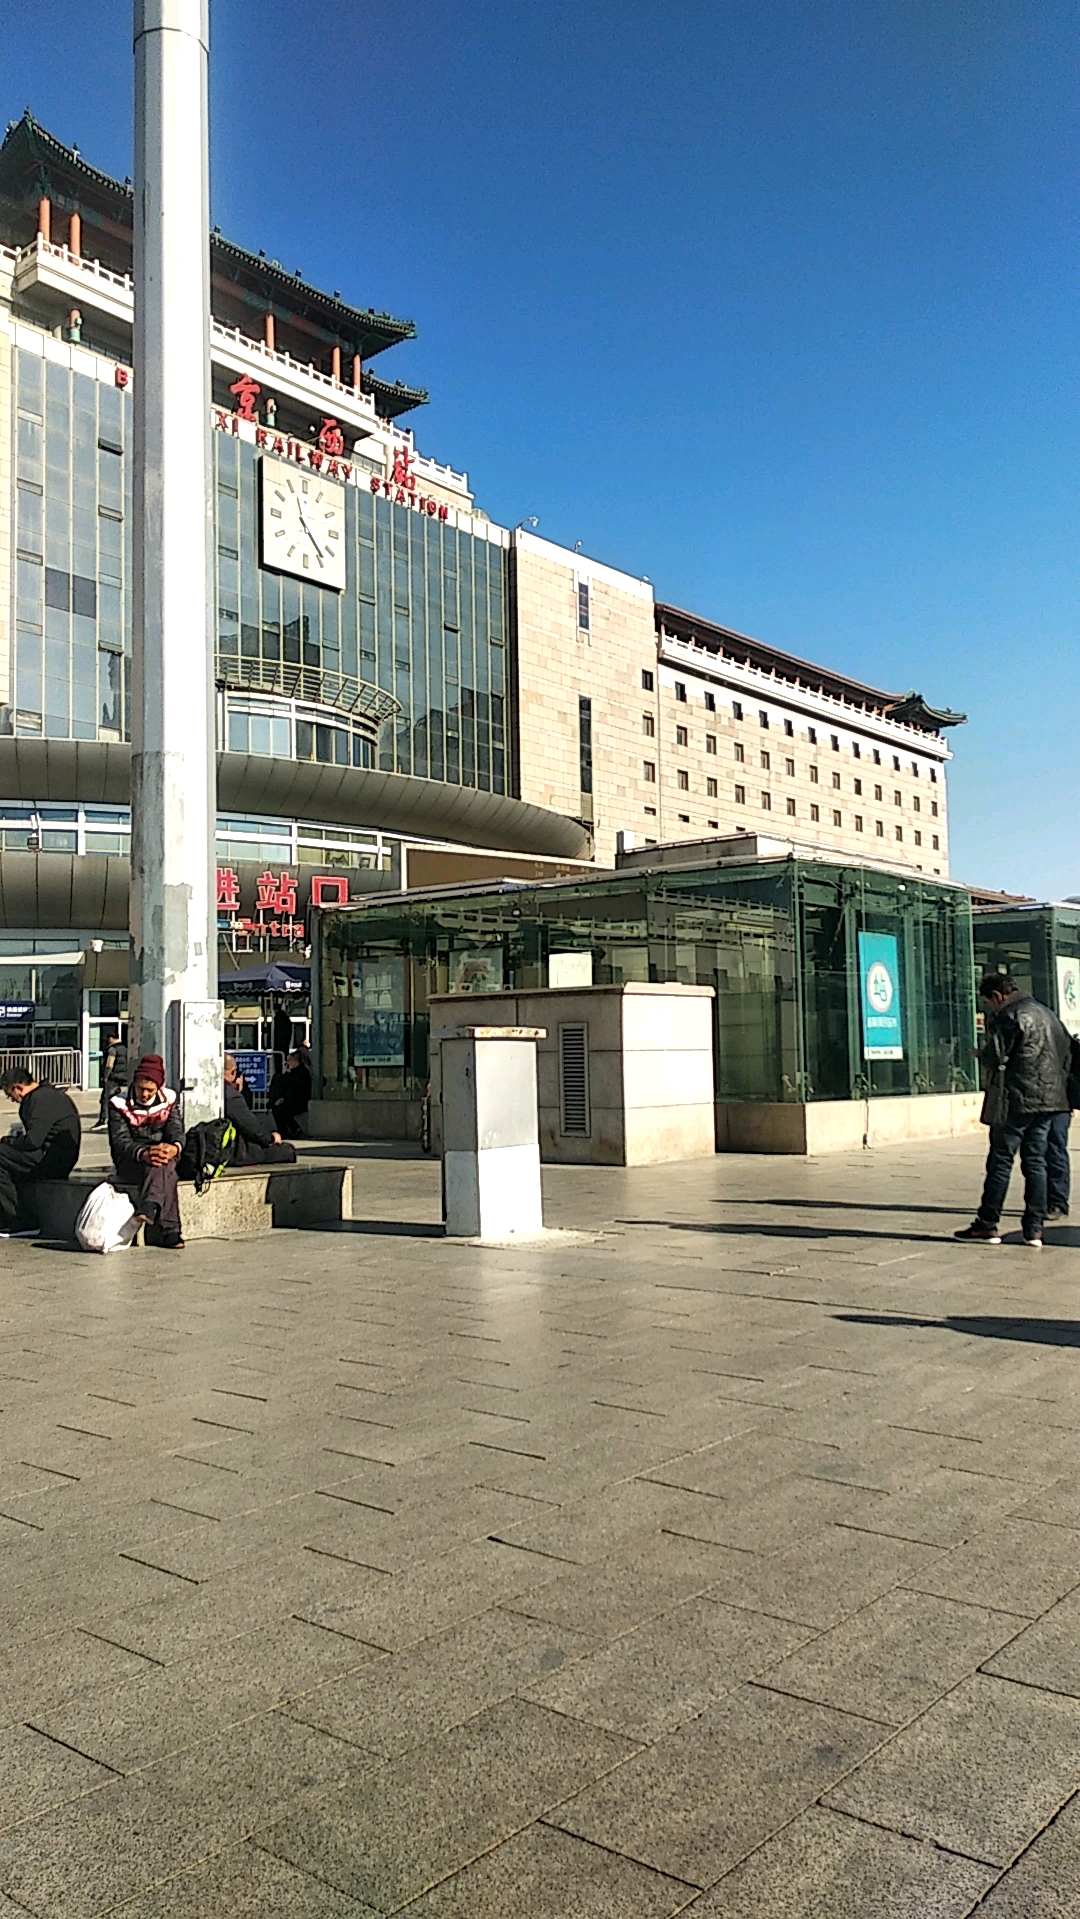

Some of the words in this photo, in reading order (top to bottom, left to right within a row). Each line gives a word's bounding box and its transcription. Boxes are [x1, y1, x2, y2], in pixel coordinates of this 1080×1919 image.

[215, 411, 239, 438] XI
[256, 427, 352, 481] RAILWAY
[370, 476, 449, 520] STATION
[217, 867, 348, 915] 进站口
[237, 918, 304, 938] Entra
